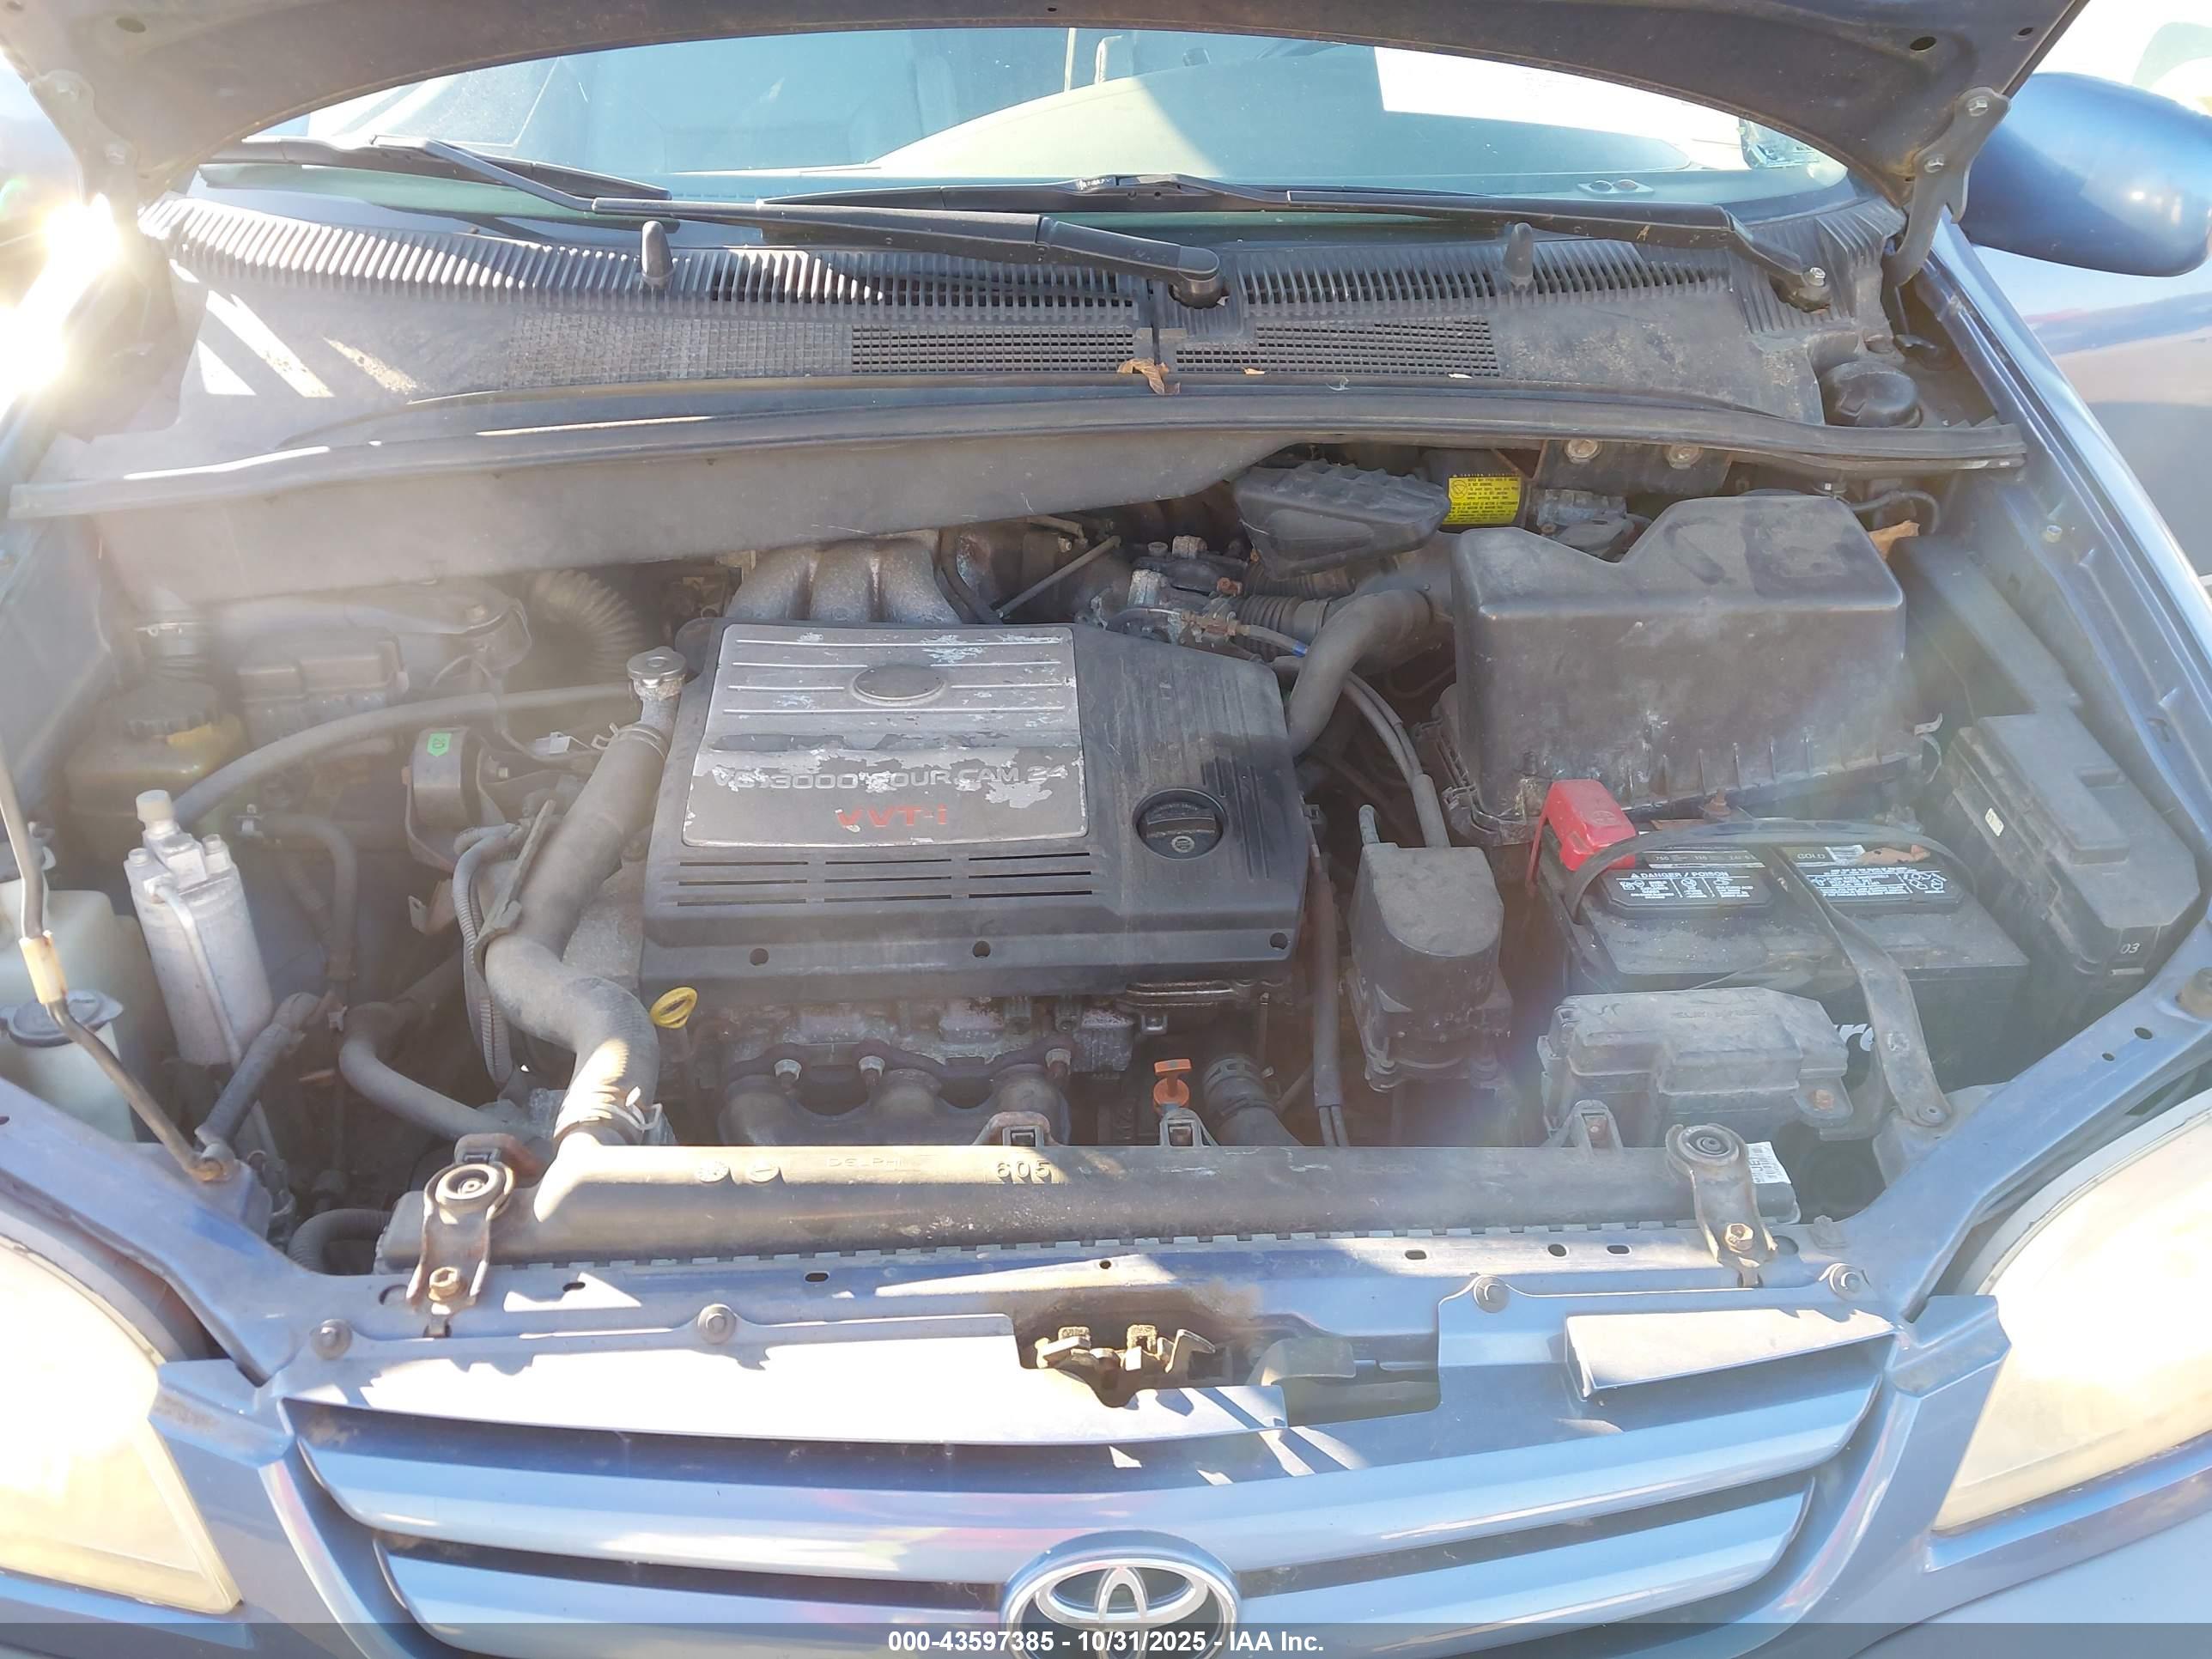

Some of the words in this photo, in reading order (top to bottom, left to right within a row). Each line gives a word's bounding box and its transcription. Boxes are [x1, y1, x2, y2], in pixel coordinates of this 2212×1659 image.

[769, 772, 859, 790] 3000
[957, 767, 1020, 784] CAM
[1027, 765, 1068, 781] 24
[2119, 942, 2141, 955] 03
[995, 1159, 1053, 1180] 605
